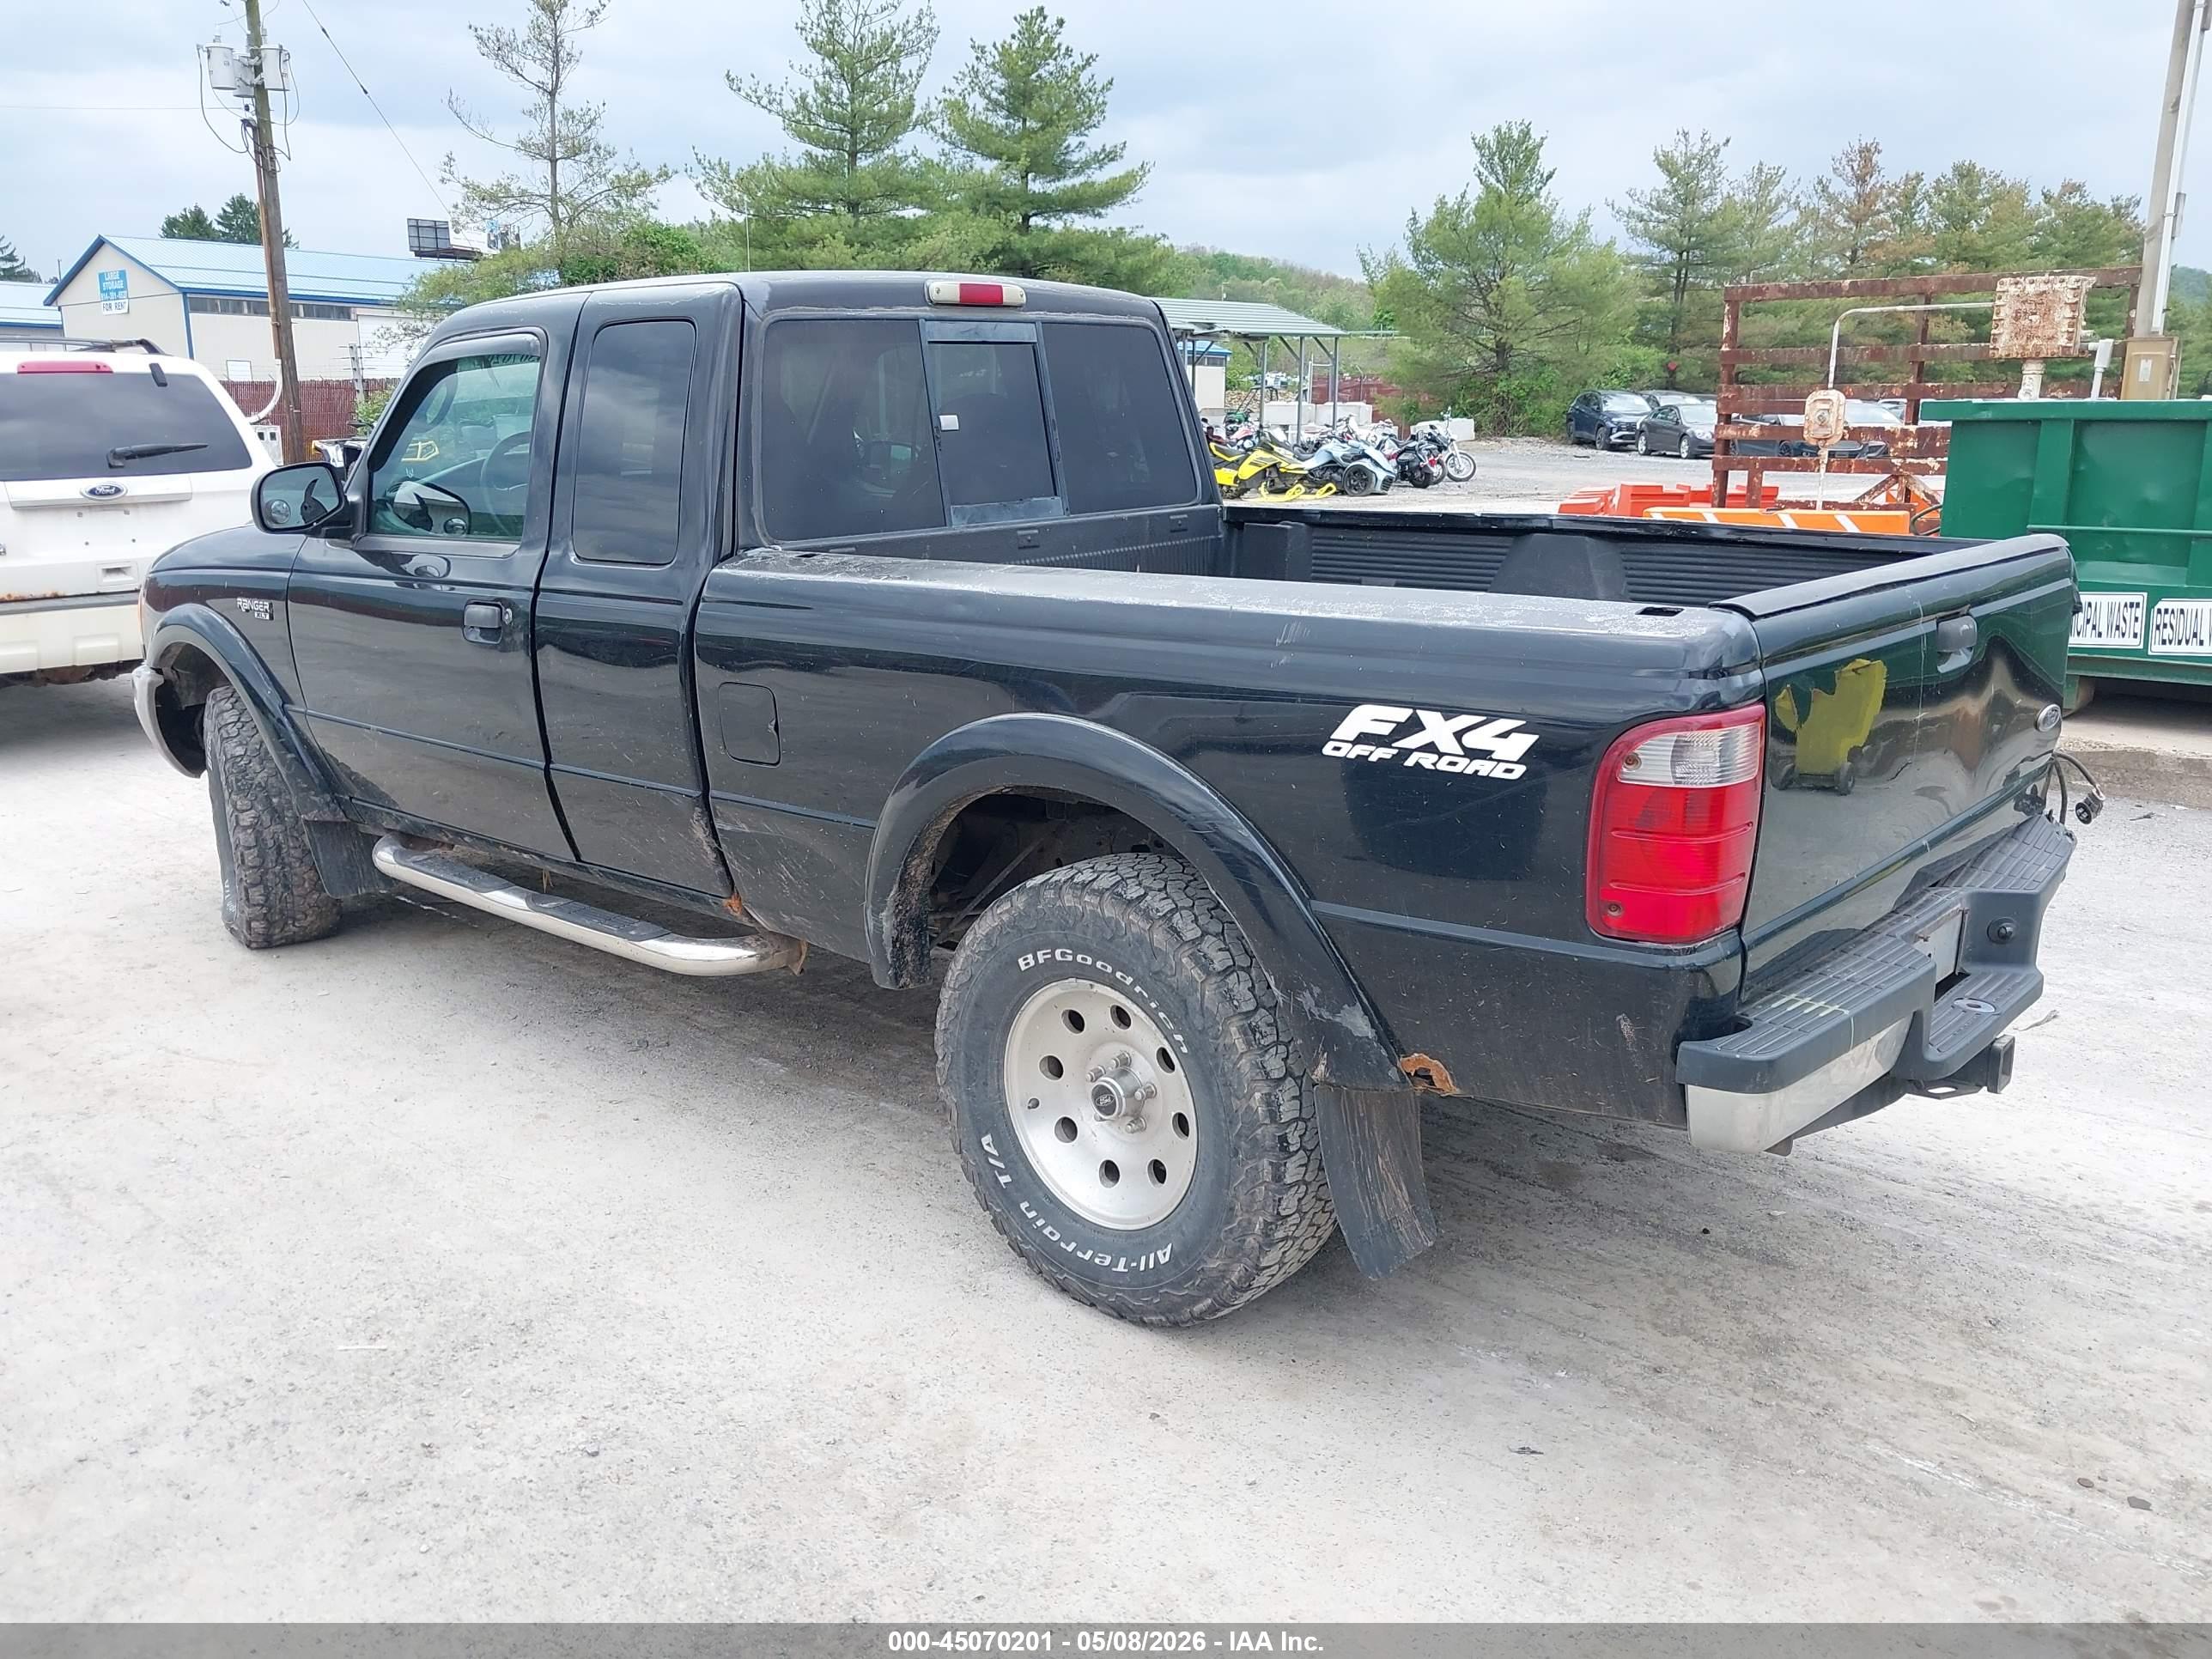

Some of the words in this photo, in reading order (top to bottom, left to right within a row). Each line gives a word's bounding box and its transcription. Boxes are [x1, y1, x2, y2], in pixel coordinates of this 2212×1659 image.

[103, 302, 112, 311] FOR
[114, 301, 126, 310] RENT
[94, 485, 116, 495] Ford
[2070, 601, 2103, 638] ICIPAL
[2106, 601, 2141, 639] WASTE
[2154, 607, 2204, 647] RESIDUAL
[1330, 703, 1540, 762] FX4
[1322, 740, 1400, 763] OFF
[1403, 750, 1528, 781] ROAD
[1017, 948, 1189, 1054] BFGoodrich
[981, 1133, 1013, 1189] T/A
[1019, 1200, 1173, 1273] All-Terrain
